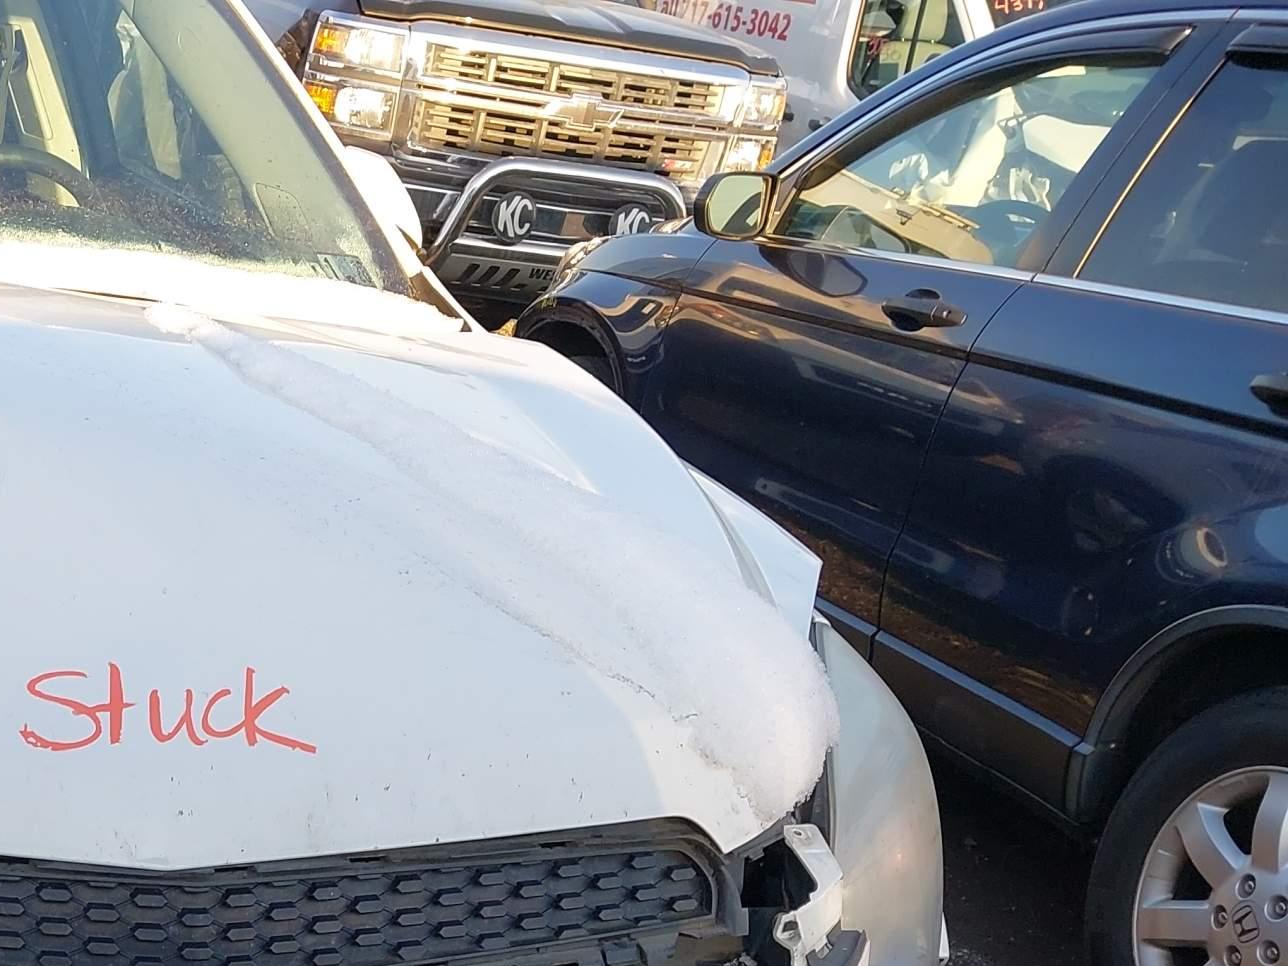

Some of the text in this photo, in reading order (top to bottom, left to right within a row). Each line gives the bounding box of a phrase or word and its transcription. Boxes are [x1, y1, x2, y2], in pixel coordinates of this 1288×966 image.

[498, 195, 533, 237] KC
[616, 207, 650, 234] KC
[19, 661, 317, 754] Stuck
